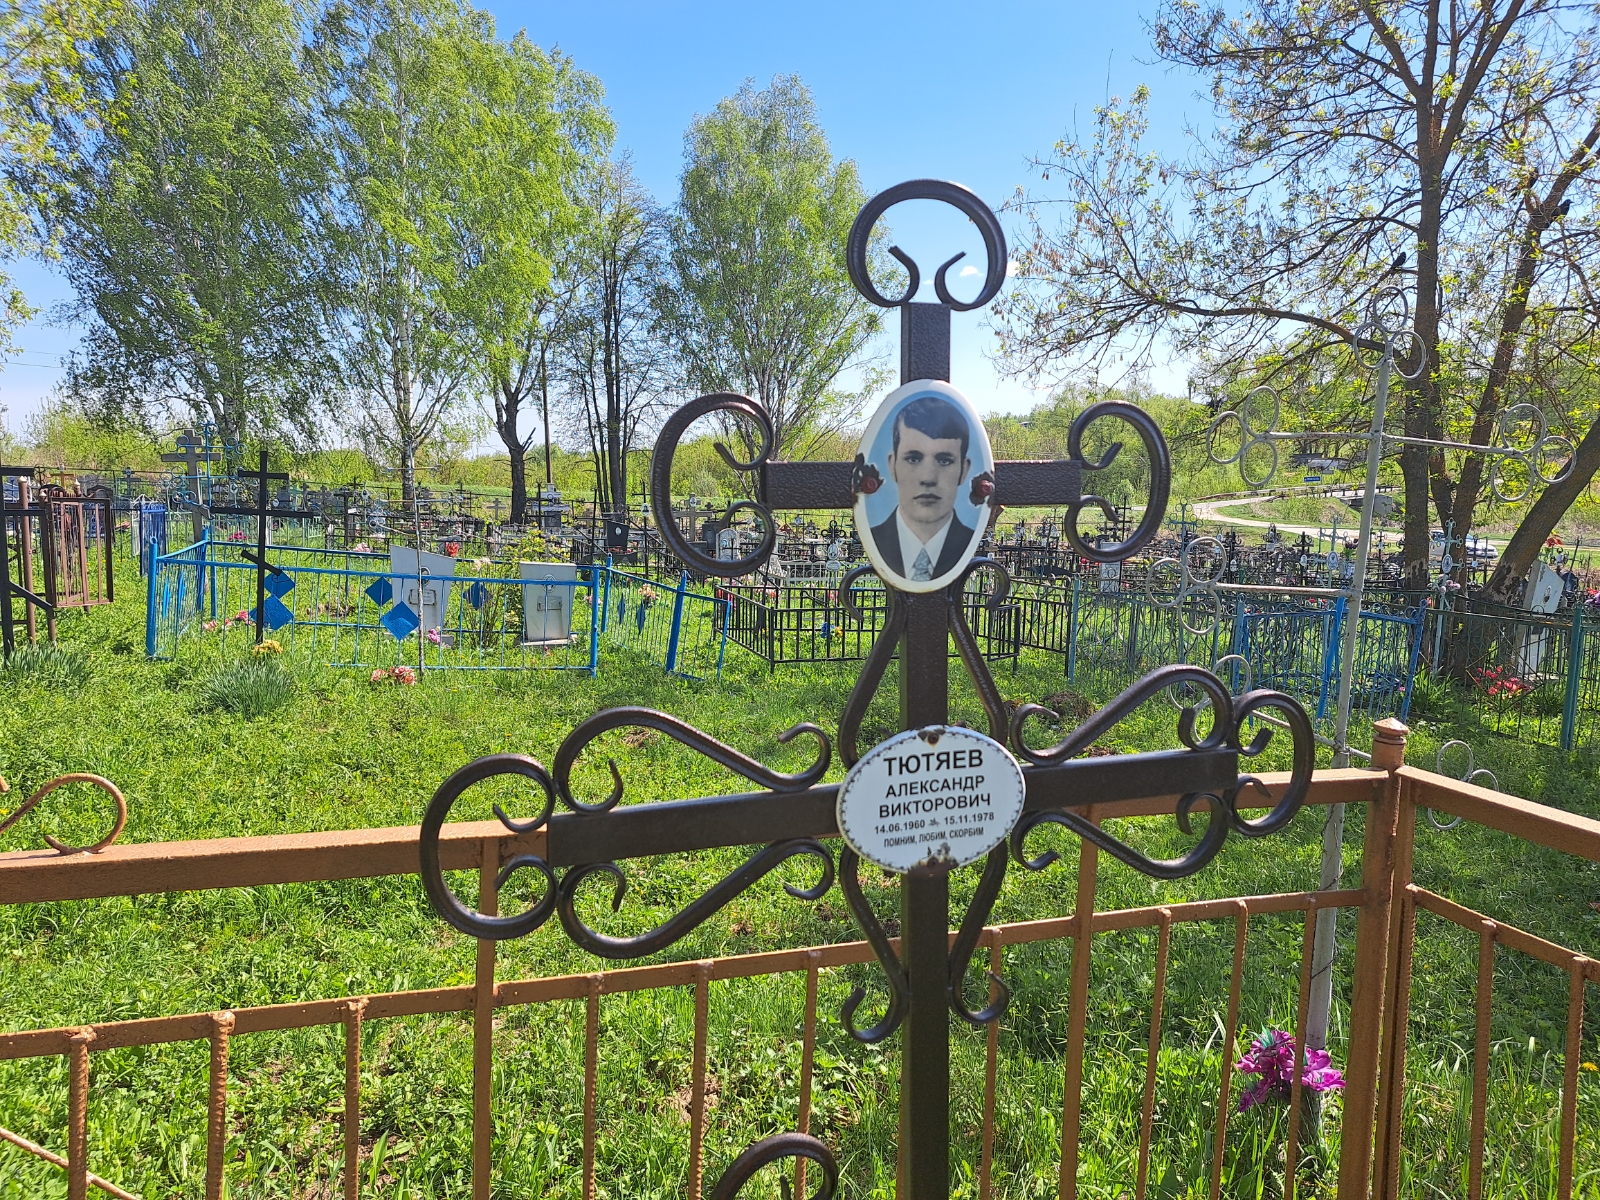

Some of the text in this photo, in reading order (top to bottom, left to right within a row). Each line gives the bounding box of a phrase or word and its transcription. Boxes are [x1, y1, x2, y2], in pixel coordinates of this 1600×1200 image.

[883, 749, 983, 776] ТЮТЯЕВ
[885, 775, 985, 798] АЛЕКСАНДР
[879, 793, 991, 818] ВИКТОРОВИЧ
[874, 812, 994, 834] 14.06.1960 15.11.1978
[884, 827, 984, 847] ПОМНИМ, ЛЮБИМ, СКОРБИМ
